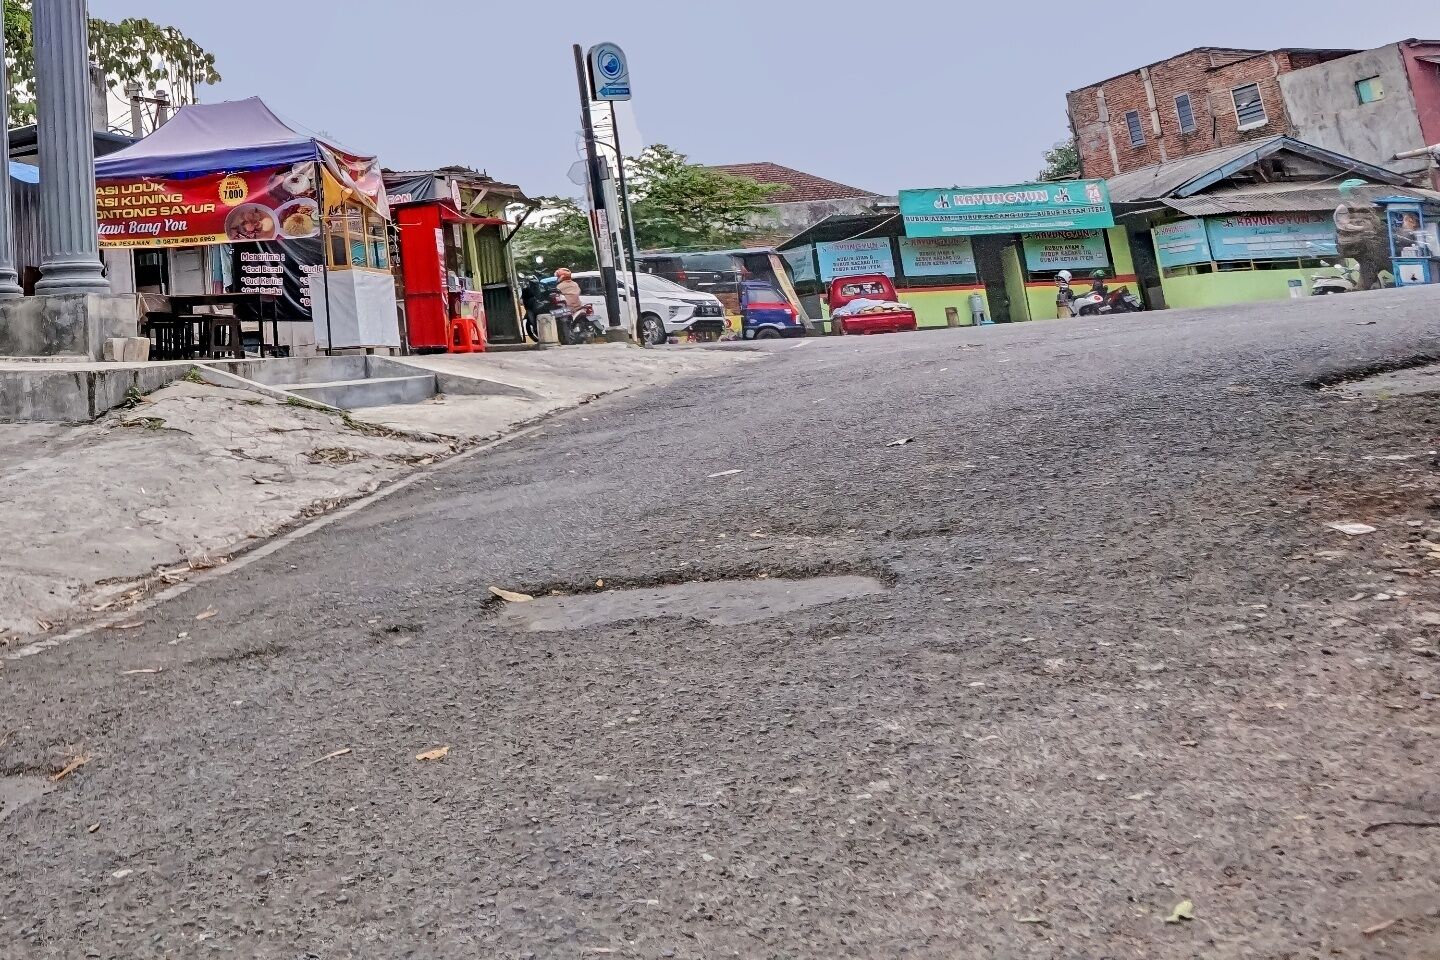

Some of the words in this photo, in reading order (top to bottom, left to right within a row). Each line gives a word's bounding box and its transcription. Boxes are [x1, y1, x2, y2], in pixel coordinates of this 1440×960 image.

[121, 183, 166, 194] UDUK
[121, 193, 183, 206] KUNING
[954, 190, 1049, 206] KAYUNGYUN
[160, 204, 216, 216] SAYUR
[1237, 215, 1309, 227] KAYUNGYUN
[129, 221, 162, 236] Bang
[164, 219, 187, 232] Yon
[241, 252, 280, 261] Menerima
[245, 277, 260, 285] Cuci
